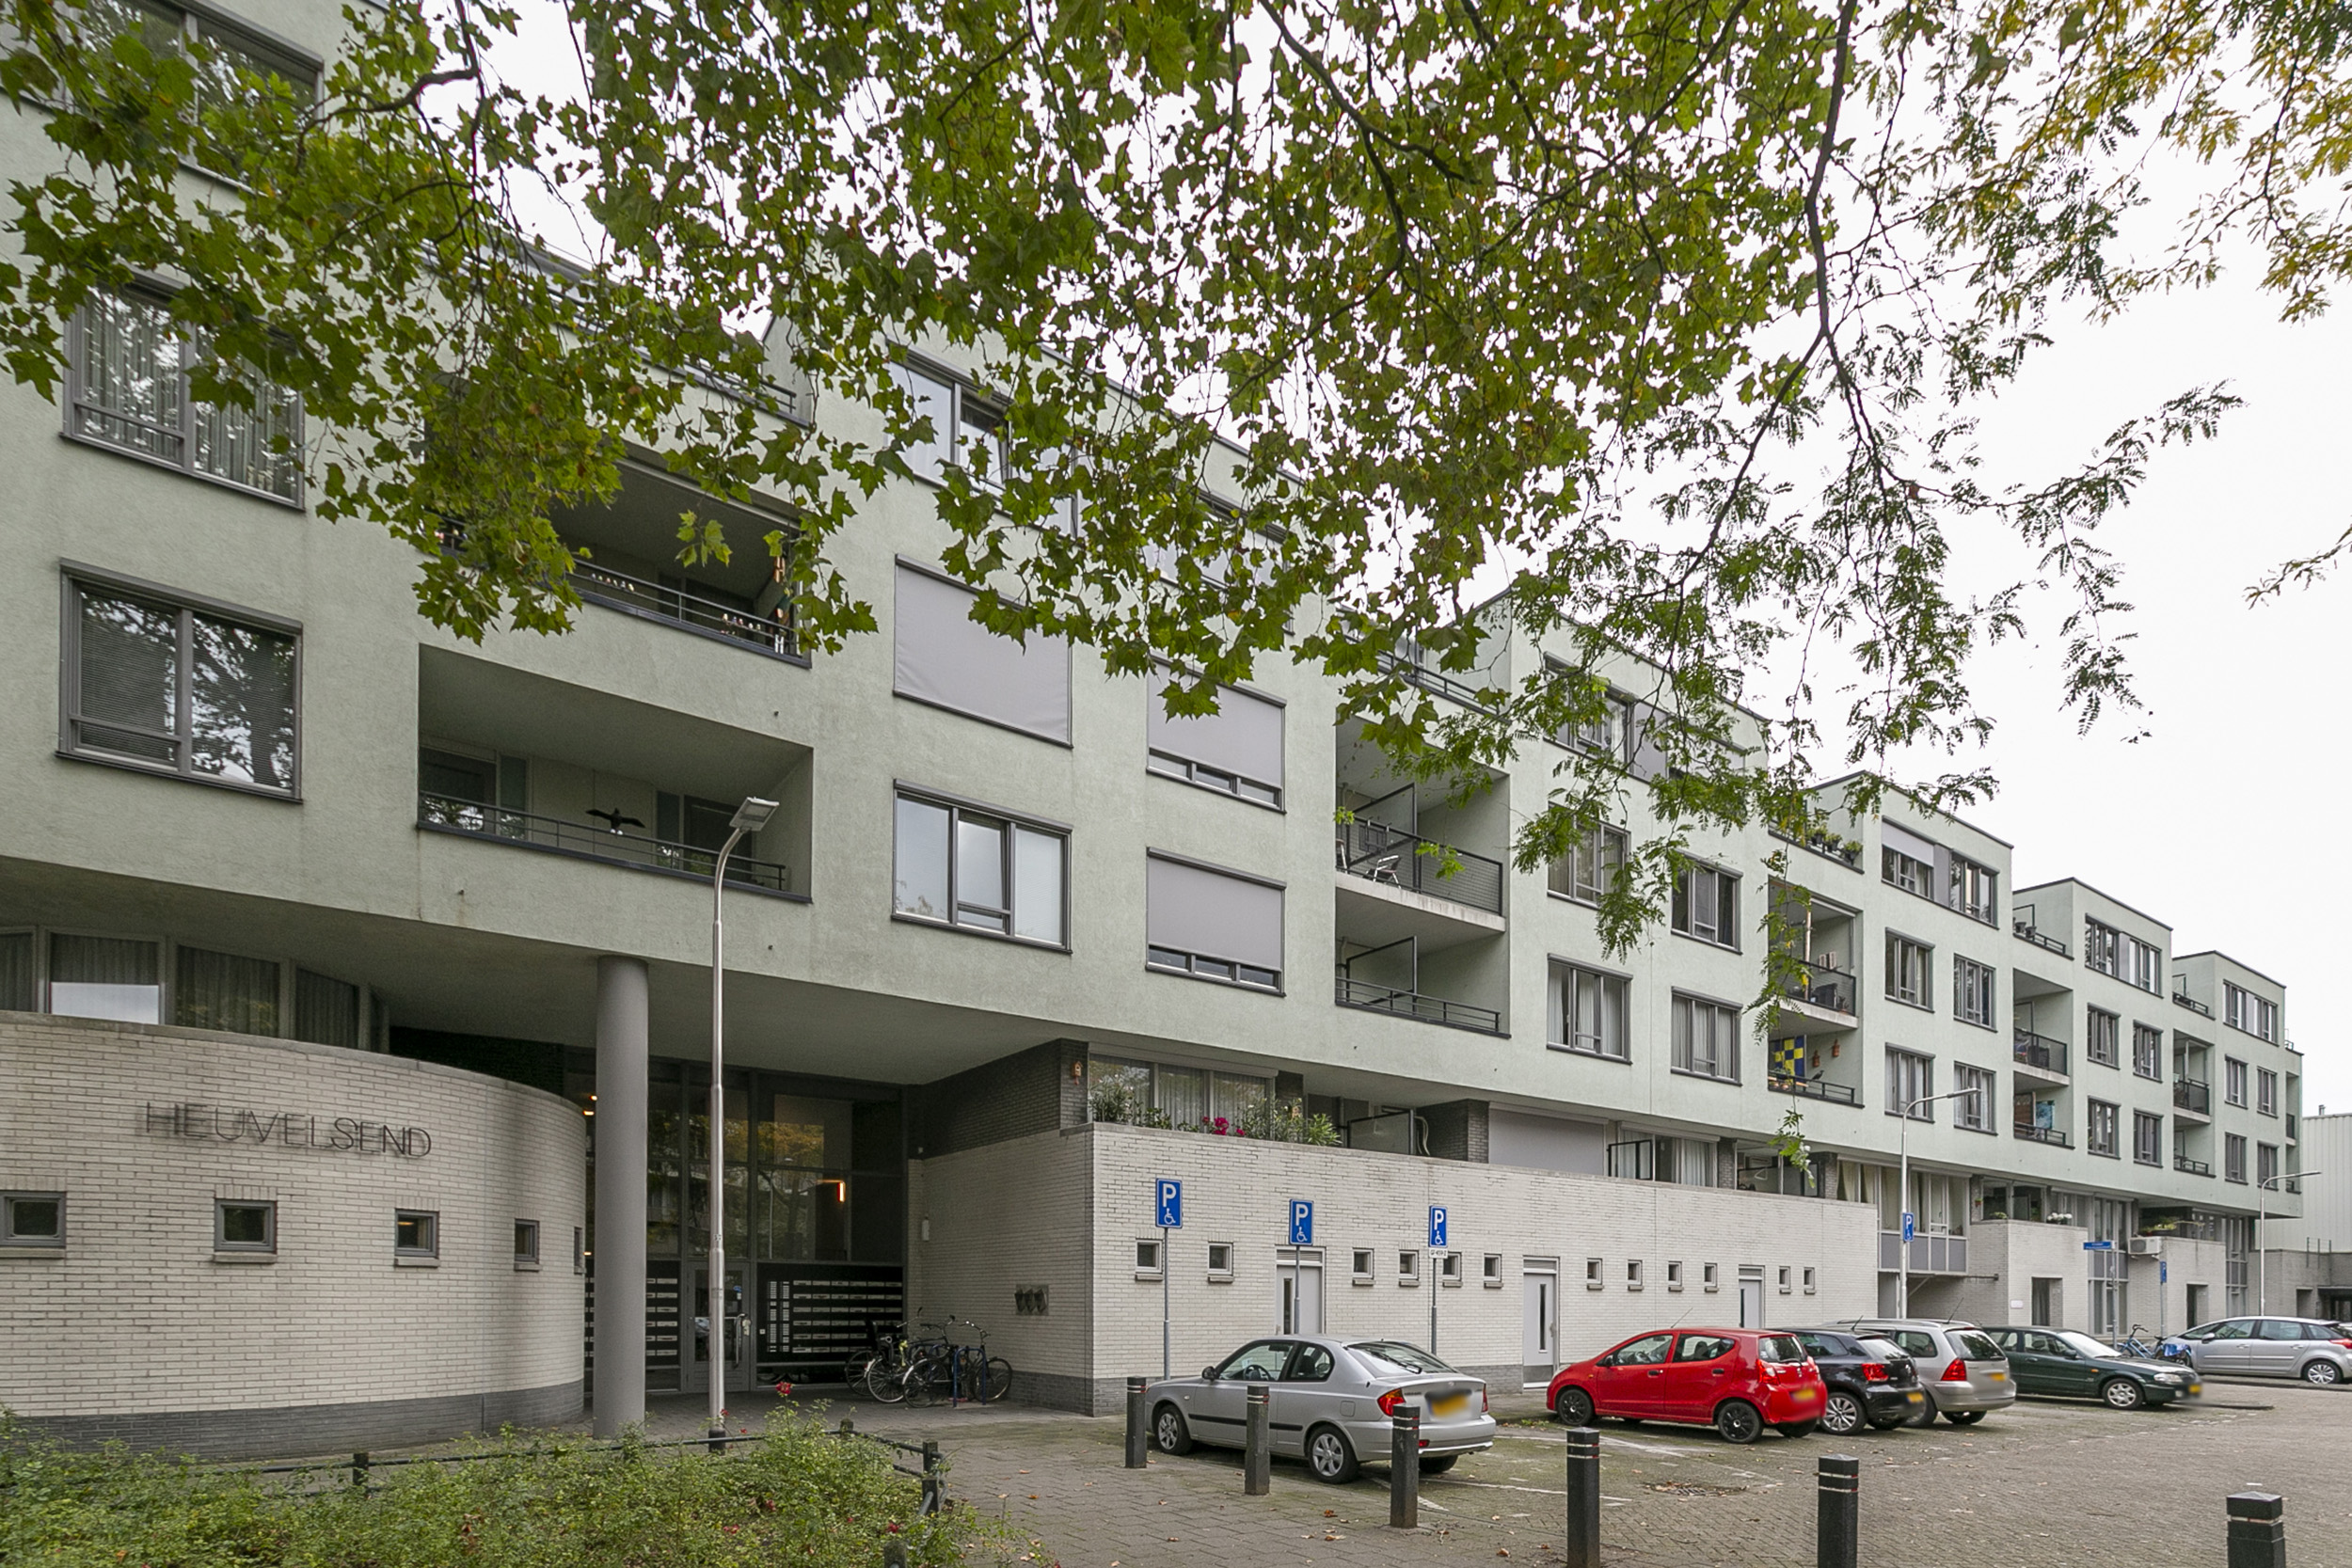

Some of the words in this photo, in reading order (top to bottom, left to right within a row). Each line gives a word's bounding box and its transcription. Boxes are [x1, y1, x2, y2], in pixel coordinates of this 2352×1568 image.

[146, 1101, 432, 1158] HEUVELSEND
[1162, 1182, 1177, 1208] P
[1295, 1203, 1309, 1227] P
[1434, 1210, 1444, 1230] P
[1905, 1214, 1913, 1229] P
